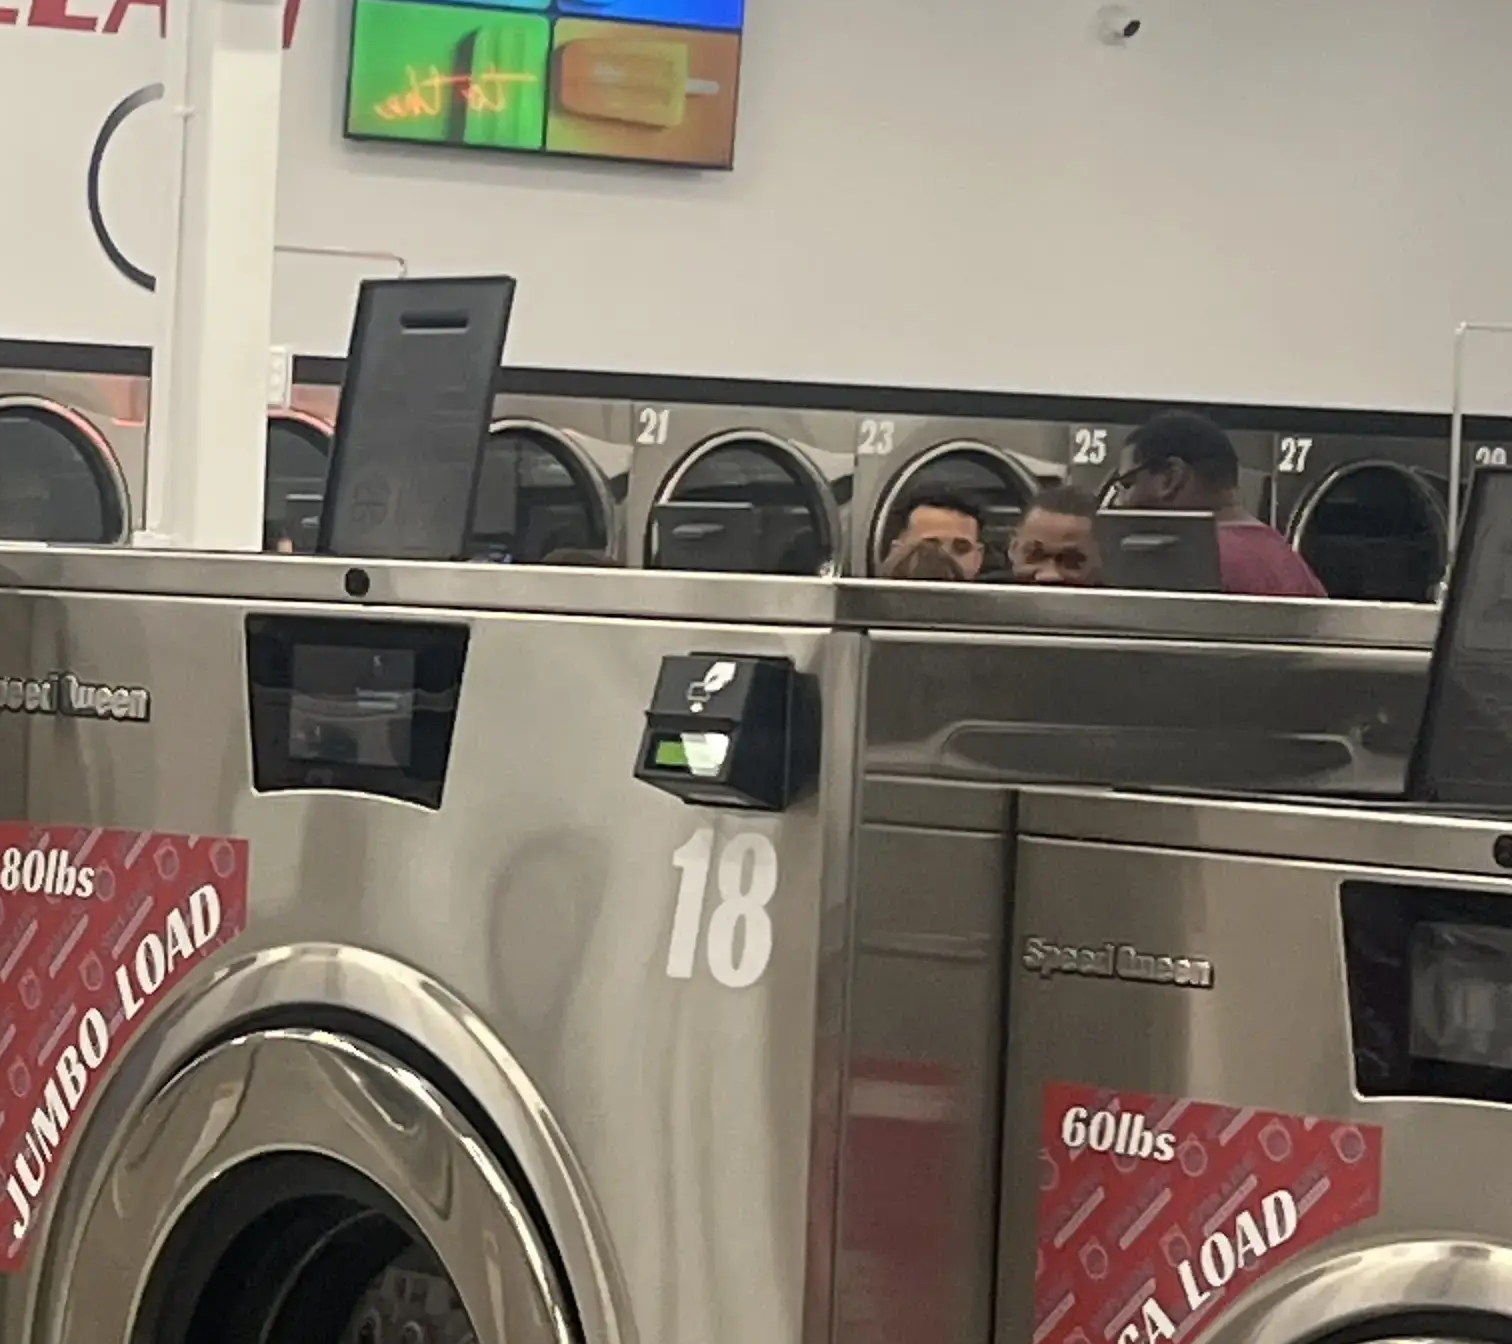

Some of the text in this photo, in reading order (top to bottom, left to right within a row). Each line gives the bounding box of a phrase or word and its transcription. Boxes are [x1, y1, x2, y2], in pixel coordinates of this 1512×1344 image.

[636, 406, 670, 446] 21
[856, 418, 896, 457] 23
[1071, 427, 1108, 465] 25
[1278, 437, 1313, 473] 27
[0, 846, 96, 900] 80lbs
[665, 827, 778, 988] 18
[3, 883, 223, 1241] JUMBO LOAD
[1061, 1106, 1177, 1163] 60lbs
[1176, 1187, 1302, 1314] LOAD
